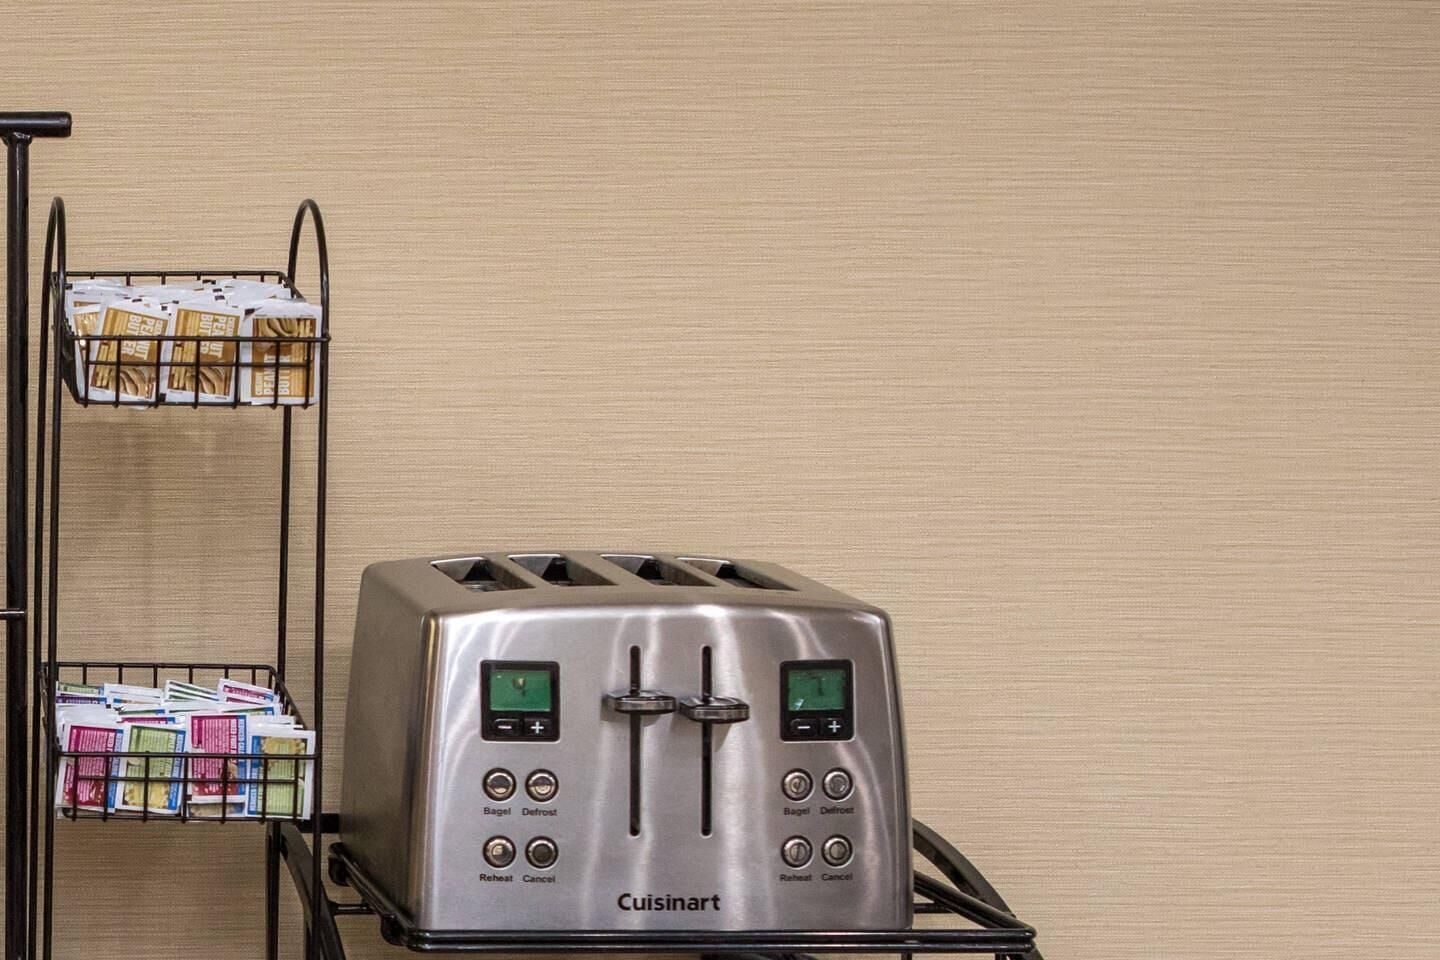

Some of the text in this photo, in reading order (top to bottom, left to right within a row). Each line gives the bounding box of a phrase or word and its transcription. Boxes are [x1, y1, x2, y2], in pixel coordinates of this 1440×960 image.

[121, 314, 143, 355] BUTER
[199, 313, 214, 354] BUTER
[483, 807, 512, 817] Bagel
[522, 807, 558, 816] Defrost
[783, 807, 810, 817] Bagel
[820, 806, 855, 815] Defrost
[479, 873, 513, 882] Reheat
[522, 874, 556, 883] Cancel
[779, 873, 812, 882] Reheat
[821, 873, 853, 881] Cancel
[617, 892, 721, 911] Cuisinart
